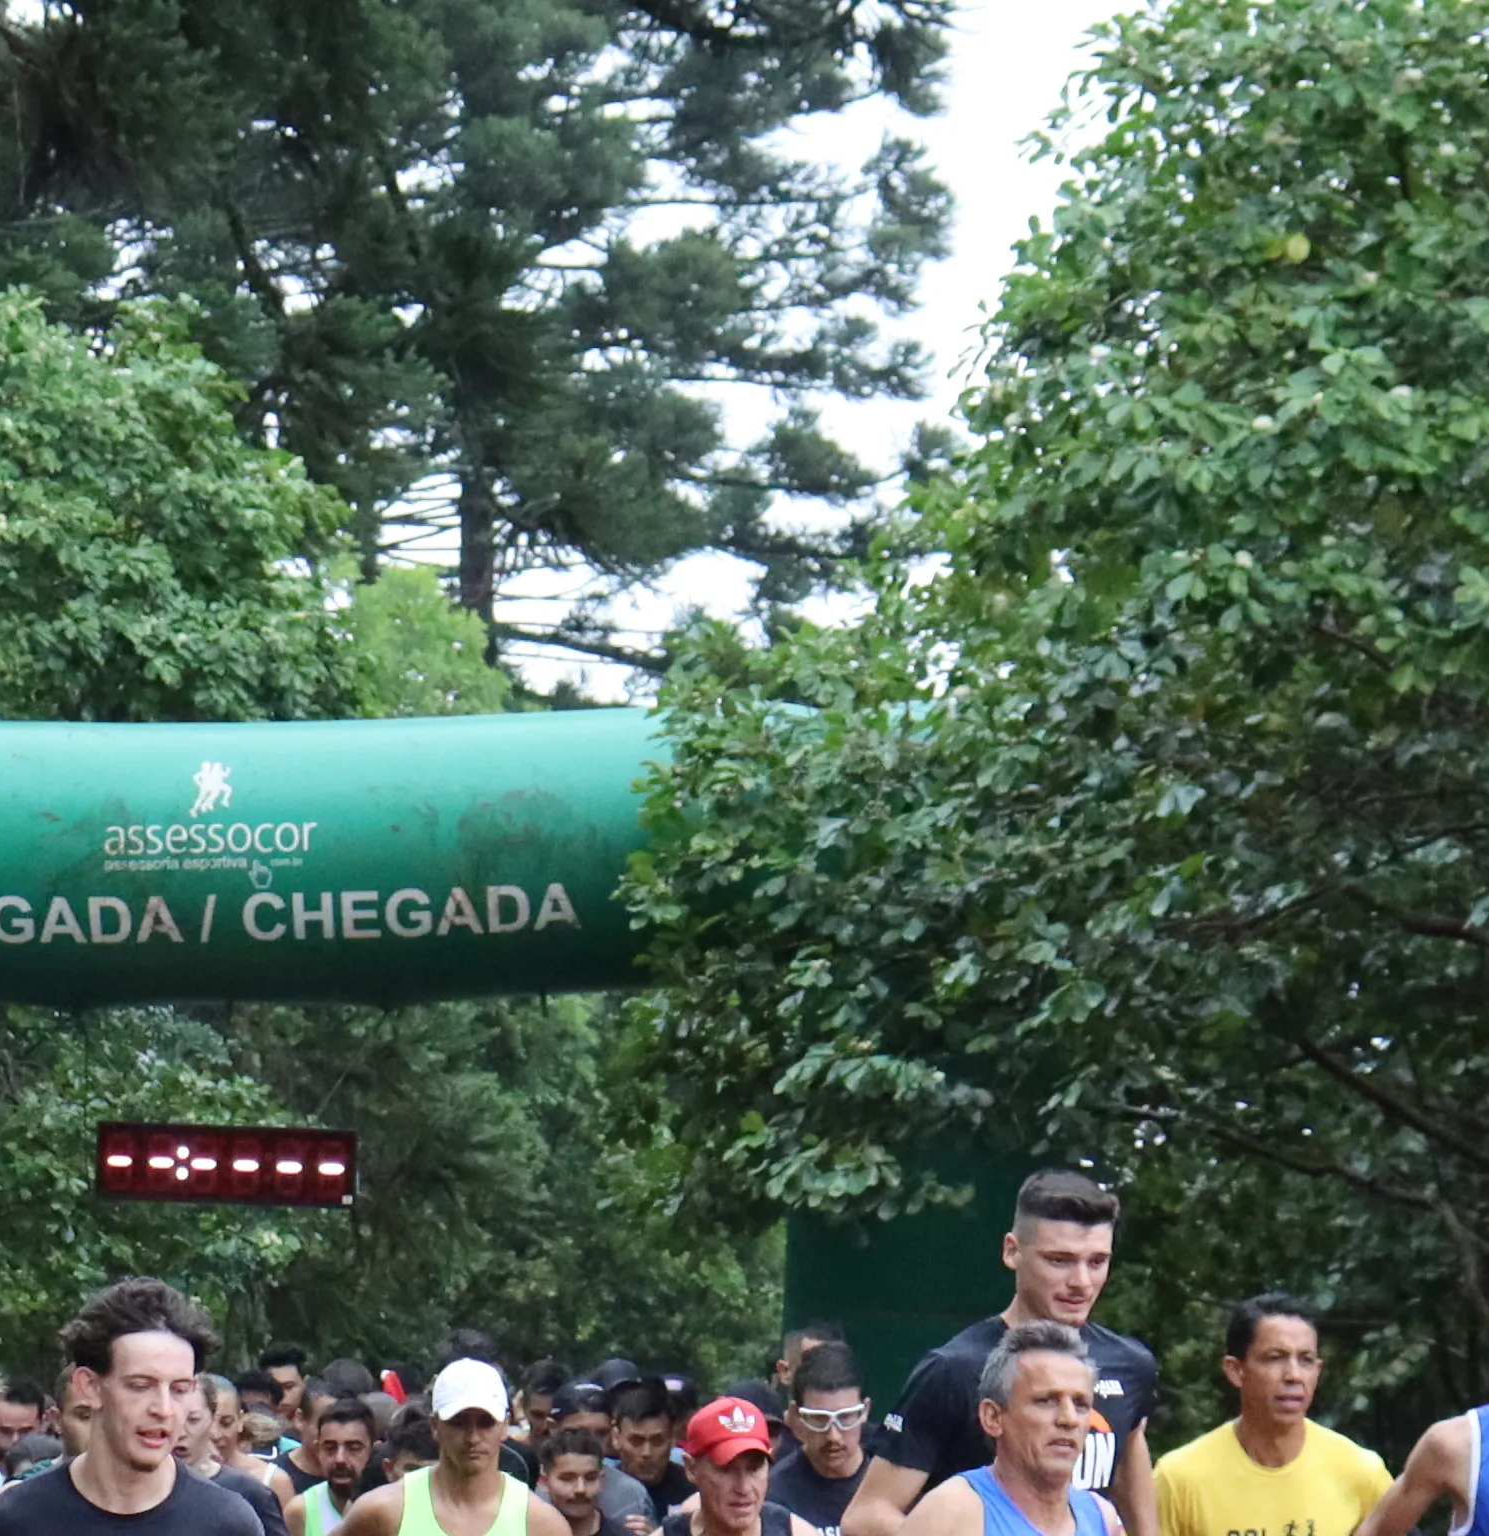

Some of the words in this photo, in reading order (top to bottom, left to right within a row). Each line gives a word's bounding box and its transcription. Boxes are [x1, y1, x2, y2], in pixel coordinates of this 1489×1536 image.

[104, 822, 318, 856] assessocor
[104, 856, 179, 871] assessoria
[182, 856, 247, 871] esportiva
[200, 894, 217, 943] /
[242, 882, 583, 942] CHEGADA
[1072, 1432, 1116, 1490] UN
